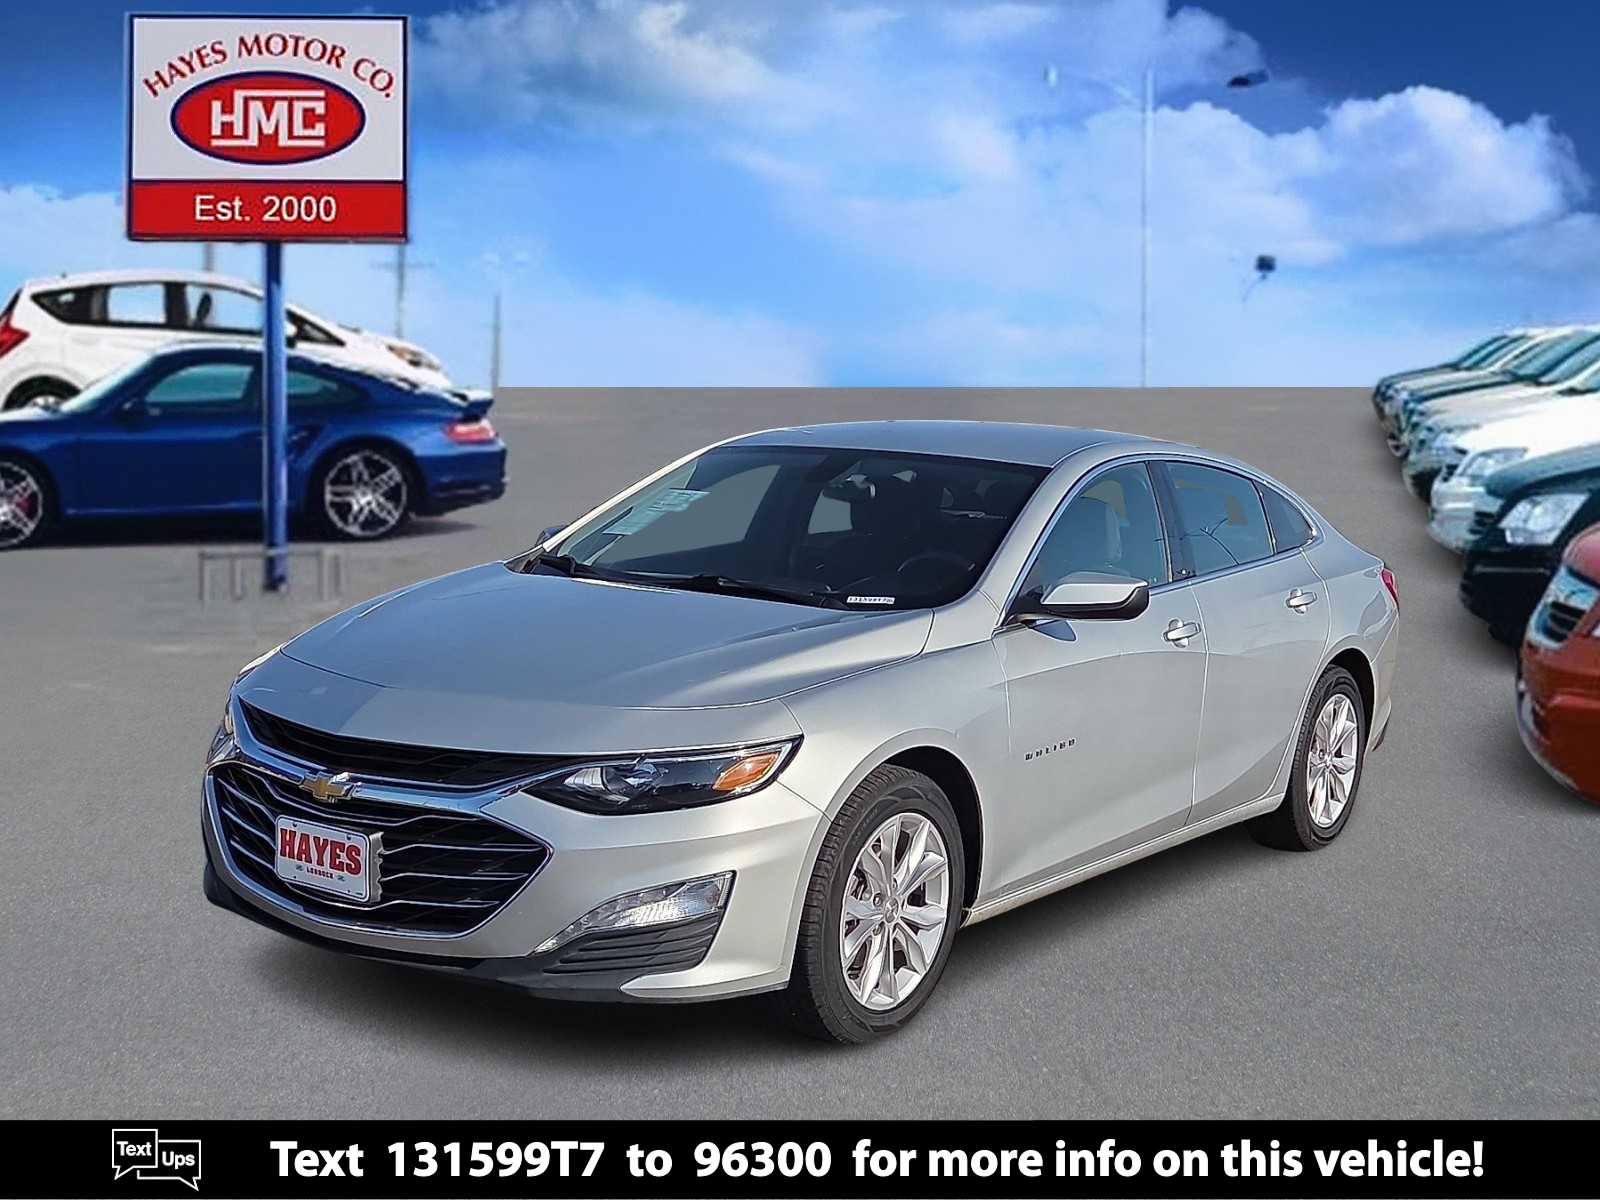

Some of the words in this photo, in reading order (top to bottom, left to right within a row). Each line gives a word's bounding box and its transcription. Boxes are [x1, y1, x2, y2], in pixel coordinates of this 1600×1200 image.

[143, 40, 228, 98] HAYES
[238, 32, 347, 70] MOTOR
[352, 57, 395, 98] CO.
[210, 88, 326, 147] HMC
[194, 194, 251, 222] Est.
[262, 195, 338, 222] 2000
[280, 827, 362, 876] HAYES
